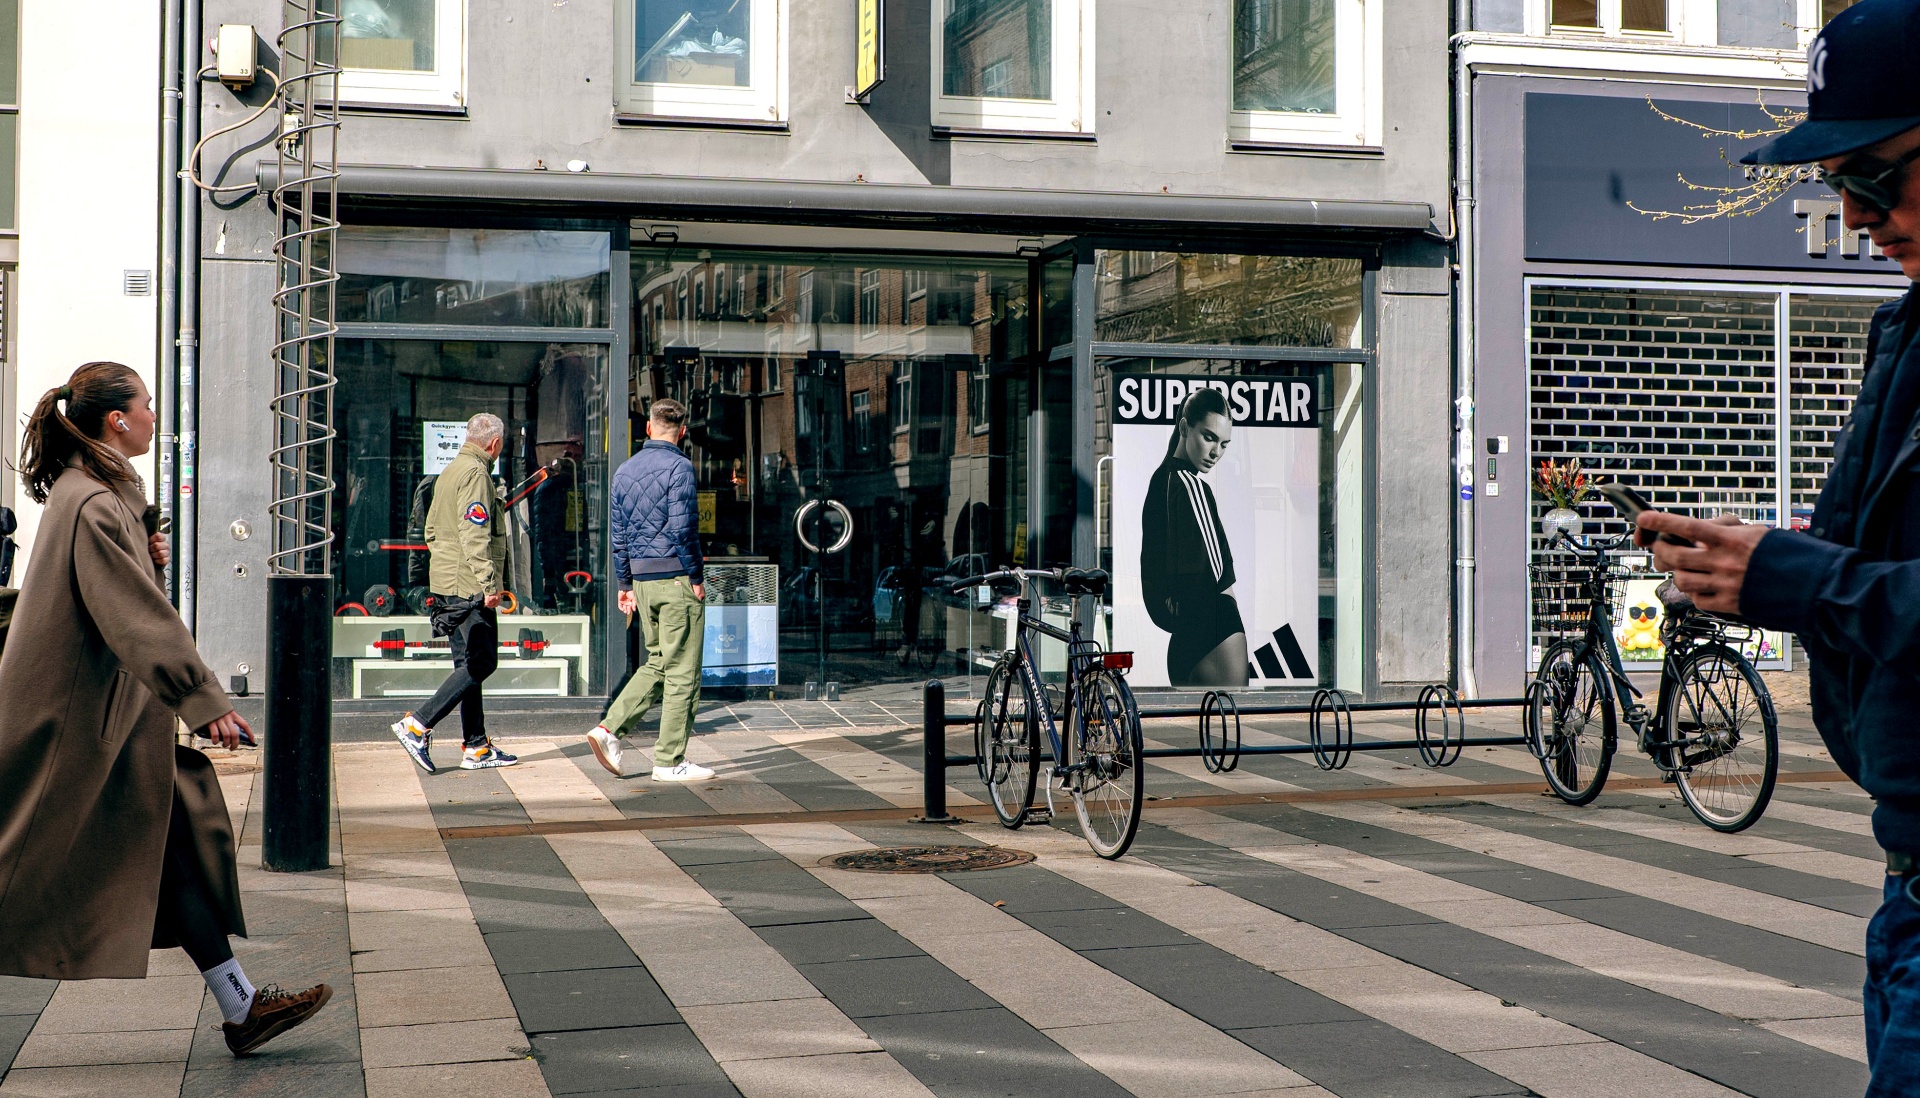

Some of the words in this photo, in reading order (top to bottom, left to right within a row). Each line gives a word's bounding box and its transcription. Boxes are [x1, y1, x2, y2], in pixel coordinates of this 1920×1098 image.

[1118, 377, 1312, 422] SUPSTAR
[715, 646, 739, 654] hummel
[1024, 660, 1051, 731] CENTURION
[226, 972, 249, 1002] SALOMON
